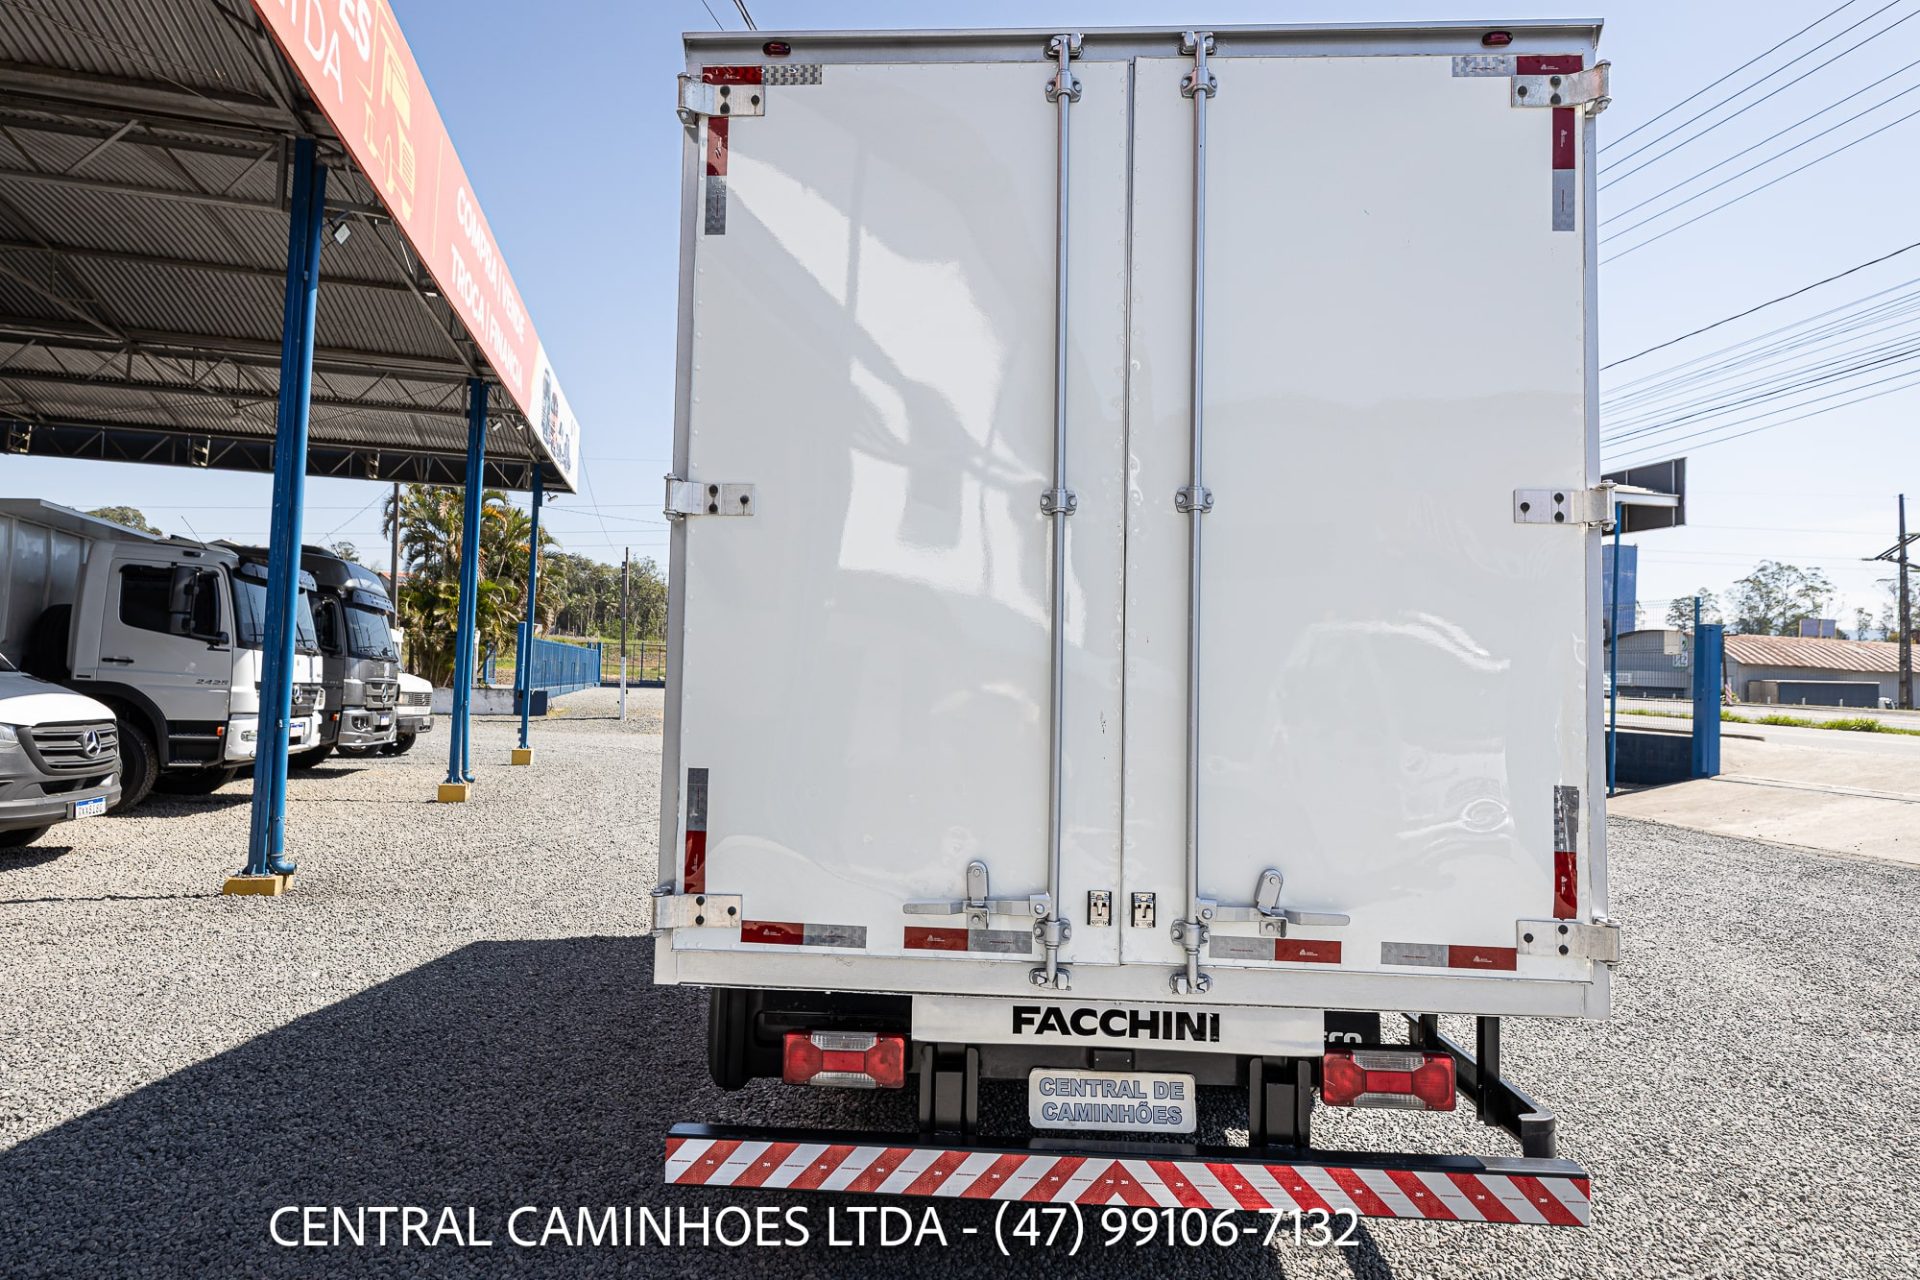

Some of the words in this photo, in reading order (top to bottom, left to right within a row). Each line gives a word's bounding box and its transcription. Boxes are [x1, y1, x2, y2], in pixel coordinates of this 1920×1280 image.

[456, 186, 498, 292] COMPRA
[501, 275, 526, 344] VENDE
[451, 242, 486, 332] TROCA
[1012, 1005, 1221, 1043] FACCHINI
[1038, 1076, 1147, 1100] CENTRAL
[1155, 1081, 1185, 1101] DE
[1041, 1100, 1183, 1125] CAMINHÕES
